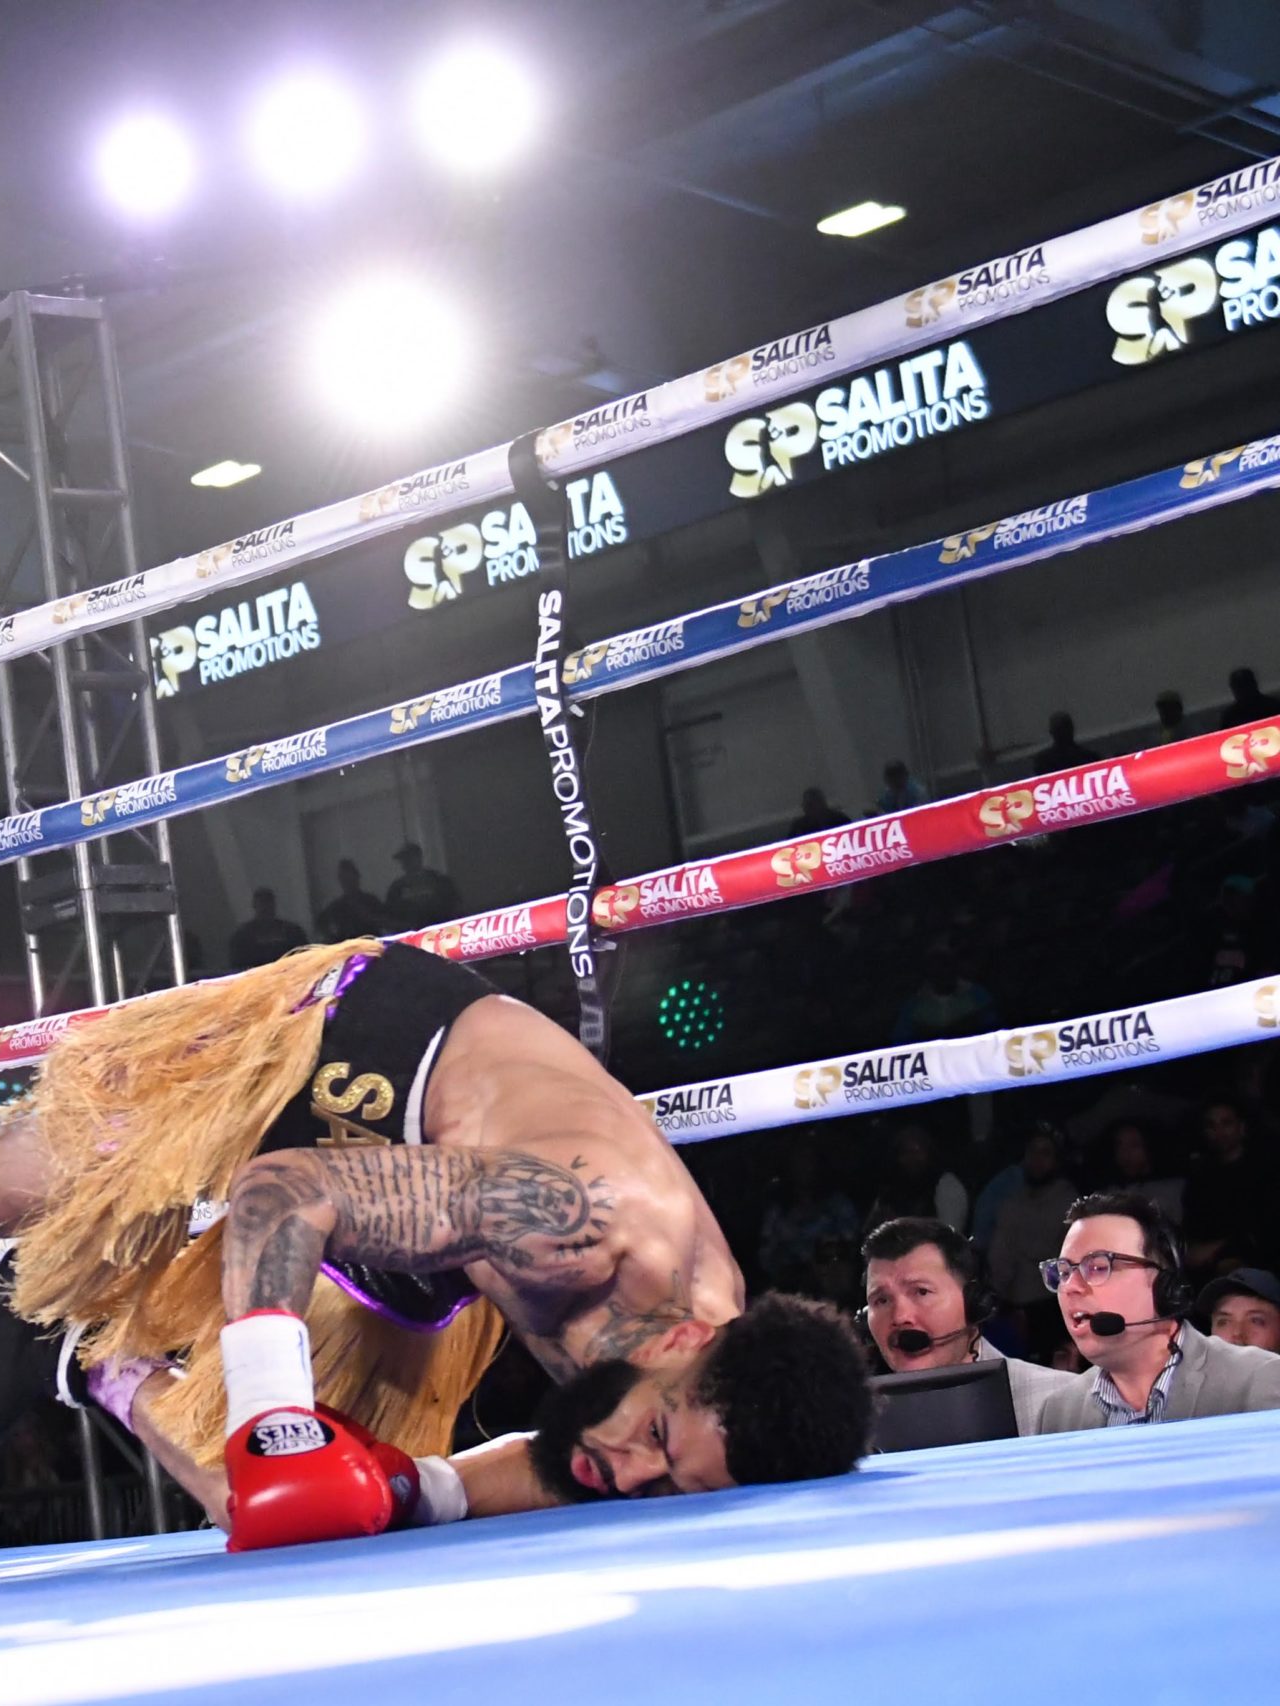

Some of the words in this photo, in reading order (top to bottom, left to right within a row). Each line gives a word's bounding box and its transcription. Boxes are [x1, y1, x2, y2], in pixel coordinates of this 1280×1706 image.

[1198, 183, 1280, 228] PROMOTIO
[956, 247, 1046, 293] SALITA
[959, 269, 1050, 312] PROMOTIONS
[751, 324, 832, 371] SALITA
[752, 345, 836, 387] PROMOTIONS
[816, 341, 986, 440] SALITA
[573, 393, 647, 435] SALITA
[821, 389, 990, 471] PROMOTIONS
[574, 414, 651, 450] PROMOTIONS
[398, 462, 466, 496] SALITA
[398, 479, 470, 511] PROMOTIONS
[481, 471, 624, 559] SATA
[994, 507, 1087, 549] PROMOTIONS
[995, 493, 1088, 533] SALITA
[232, 520, 295, 554] SALITA
[232, 536, 296, 567] PROMOTIONS
[87, 573, 145, 602] SALITA
[786, 572, 870, 614] PROMOTIONS
[787, 559, 870, 597] SALITA
[86, 588, 146, 614] PROMOTIONS
[195, 582, 319, 660] SALITA
[607, 621, 684, 654] SALITA
[199, 623, 320, 685] PROMOTIONS
[535, 590, 562, 727] SALITA
[606, 634, 684, 671] PROMOTIONS
[431, 676, 501, 708] SALITA
[431, 690, 501, 724] PROMOTIONS
[262, 731, 326, 759] SALITA
[262, 743, 327, 773] PROMOTIONS
[115, 772, 174, 804] SALITA
[115, 788, 177, 816] PROMOTIONS
[1033, 766, 1130, 812] SALITA
[1037, 791, 1136, 825] PROMOTIONS
[544, 724, 596, 978] PROMOTIONS
[821, 819, 908, 863] SALITA
[825, 844, 913, 877] PROMOTIONS
[639, 867, 718, 904] SALITA
[640, 890, 723, 918] PROMOTIONS
[461, 908, 532, 942] SALITA
[461, 932, 536, 957] PROMOTIONS
[1059, 1011, 1153, 1052] SALITA
[843, 1052, 926, 1087] SALITA
[1062, 1038, 1160, 1068] PROMOTIONS
[656, 1083, 732, 1116] SALITA
[845, 1077, 933, 1103] PROMOTIONS
[656, 1107, 736, 1131] PROMOTIONS
[256, 1420, 325, 1449] REYES
